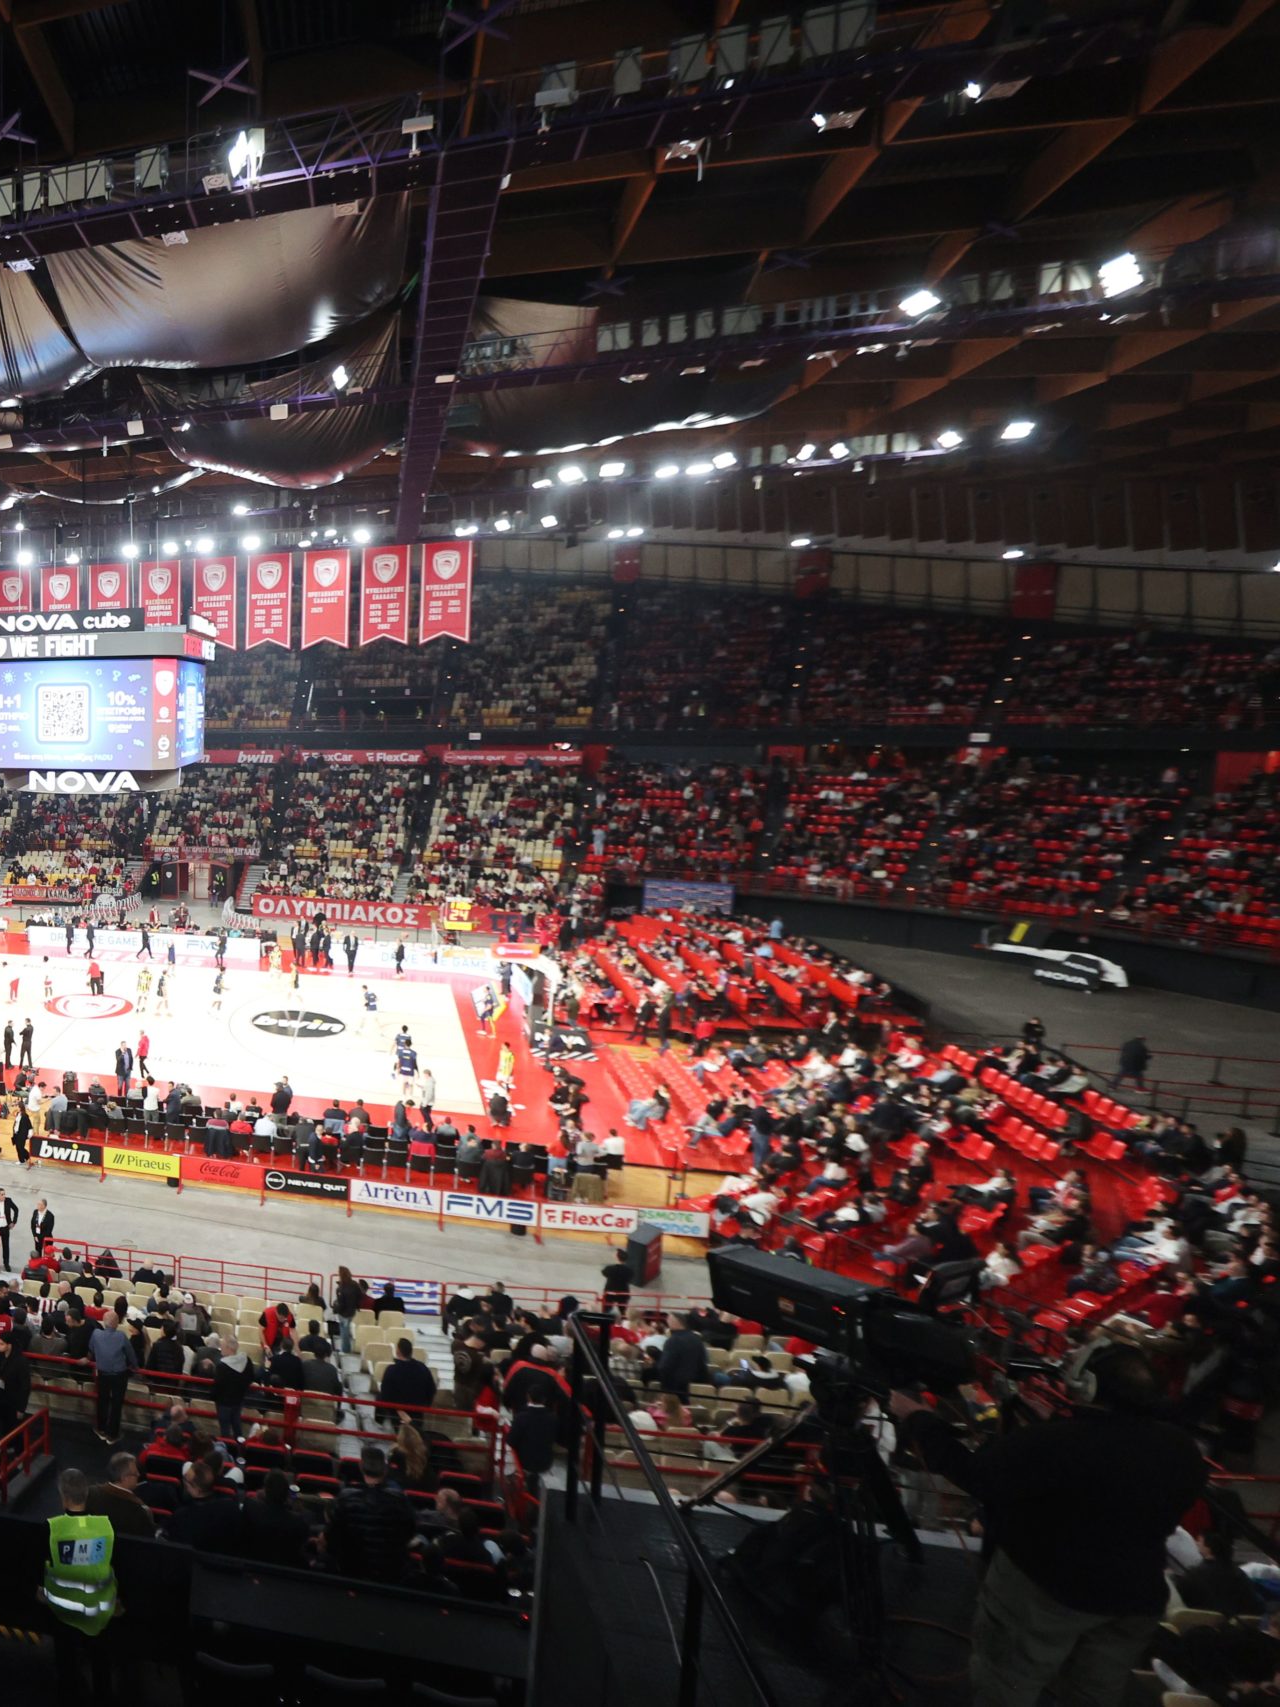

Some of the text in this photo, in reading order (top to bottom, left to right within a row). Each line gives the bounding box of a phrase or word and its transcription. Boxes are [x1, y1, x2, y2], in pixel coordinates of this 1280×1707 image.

[83, 612, 131, 629] cube
[9, 635, 39, 657] WE
[44, 634, 98, 656] FIGHT
[107, 690, 136, 706] 10%
[237, 751, 274, 763] bwin
[376, 753, 420, 762] FlexCar
[28, 770, 140, 793] NOVA
[258, 897, 419, 925] ΟΛΥΜΠΙΑΚΟΣ
[449, 910, 469, 920] 24
[107, 935, 138, 946] GAME
[253, 1015, 344, 1032] bwin
[534, 1032, 587, 1046] NVA
[39, 1140, 90, 1164] bwin
[127, 1155, 172, 1171] Piraeus
[287, 1179, 347, 1192] NEVER QUIT
[447, 1194, 534, 1222] FMS
[639, 1210, 694, 1222] OSMOTE
[561, 1210, 633, 1229] FlexCar
